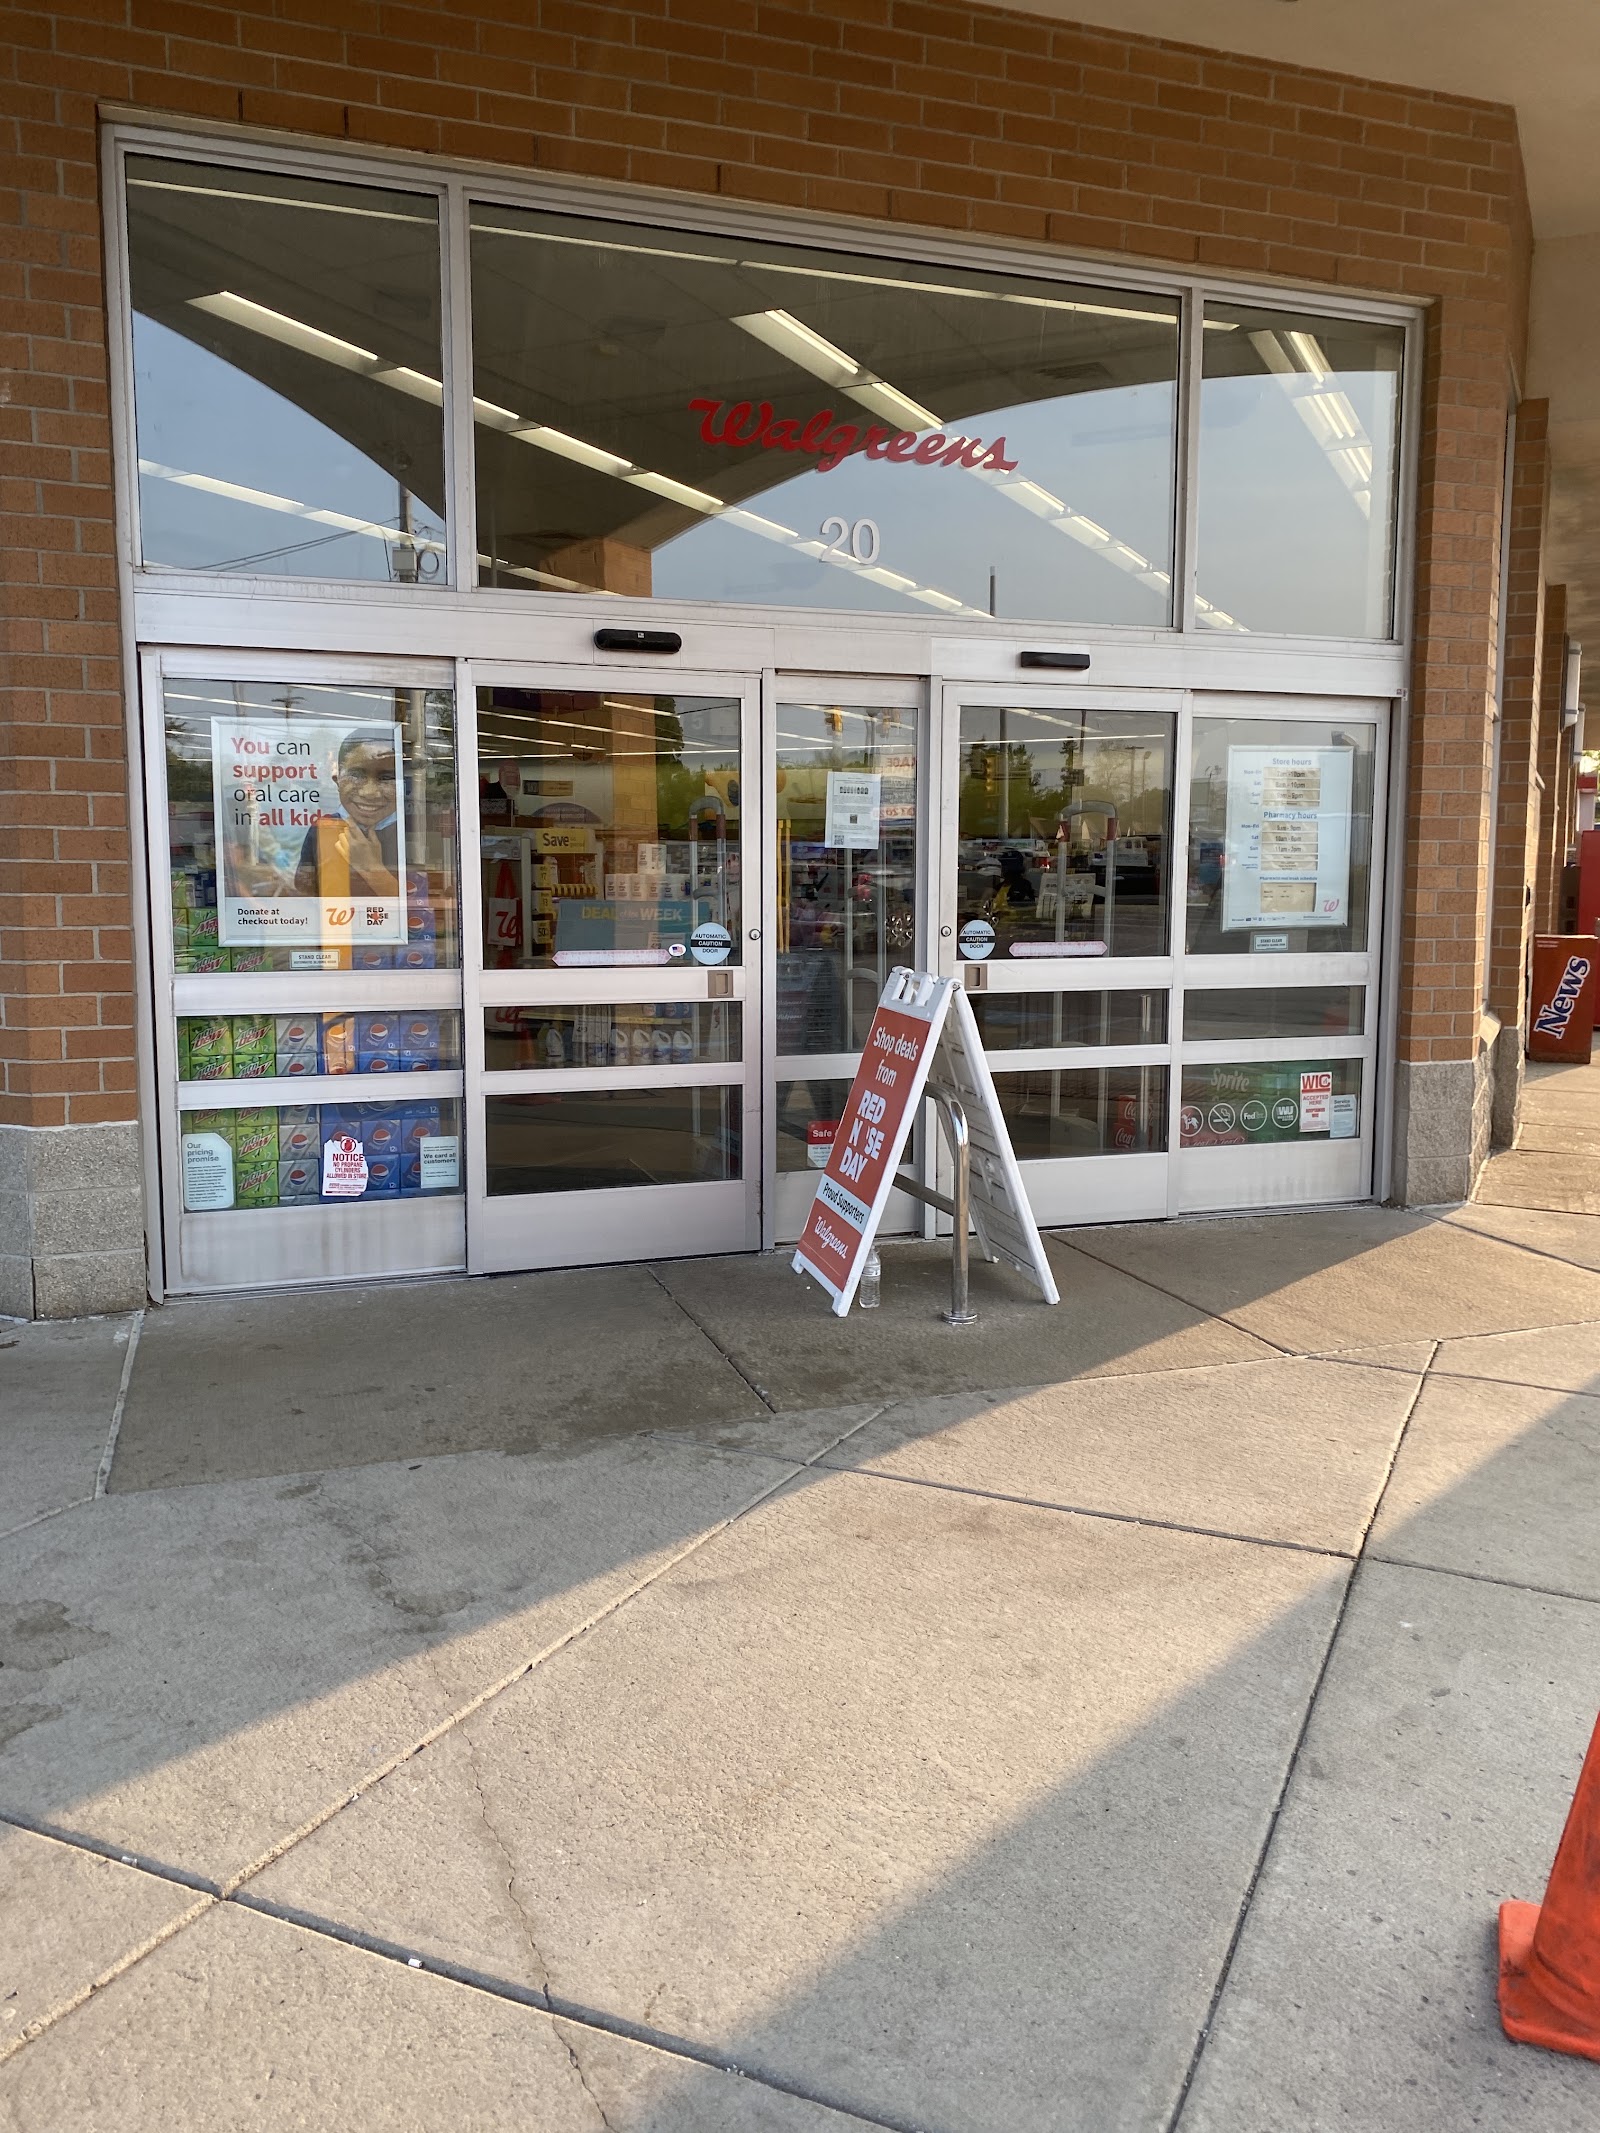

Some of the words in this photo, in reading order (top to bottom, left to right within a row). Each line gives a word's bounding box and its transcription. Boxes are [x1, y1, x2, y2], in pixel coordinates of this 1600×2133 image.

[688, 398, 1019, 473] Walgreens
[819, 516, 881, 565] 20
[231, 737, 270, 755] You
[276, 742, 311, 756] can
[232, 763, 318, 783] support
[233, 784, 272, 803] oral
[278, 789, 320, 803] care
[235, 808, 252, 826] in
[258, 808, 285, 826] all
[1263, 811, 1297, 820] Pharmacy
[1297, 811, 1318, 819] hours
[542, 832, 570, 847] Save
[237, 908, 269, 916] Donate
[270, 908, 280, 916] at
[640, 907, 683, 920] WEEK
[237, 917, 279, 925] checkout
[280, 917, 308, 927] today!
[1534, 956, 1590, 1040] News
[873, 1026, 895, 1057] Shop
[895, 1033, 919, 1062] deals
[875, 1059, 897, 1088] from
[1210, 1067, 1250, 1092] Sprite
[1301, 1073, 1331, 1090] WIC
[857, 1089, 887, 1125] RED
[812, 1129, 833, 1138] Safe
[187, 1149, 214, 1157] pricing
[187, 1156, 219, 1164] promise
[332, 1153, 364, 1162] NOTICE
[839, 1146, 868, 1183] DAY
[822, 1182, 840, 1204] Proud
[836, 1193, 865, 1224] Supporters
[814, 1216, 849, 1259] Walgreens
